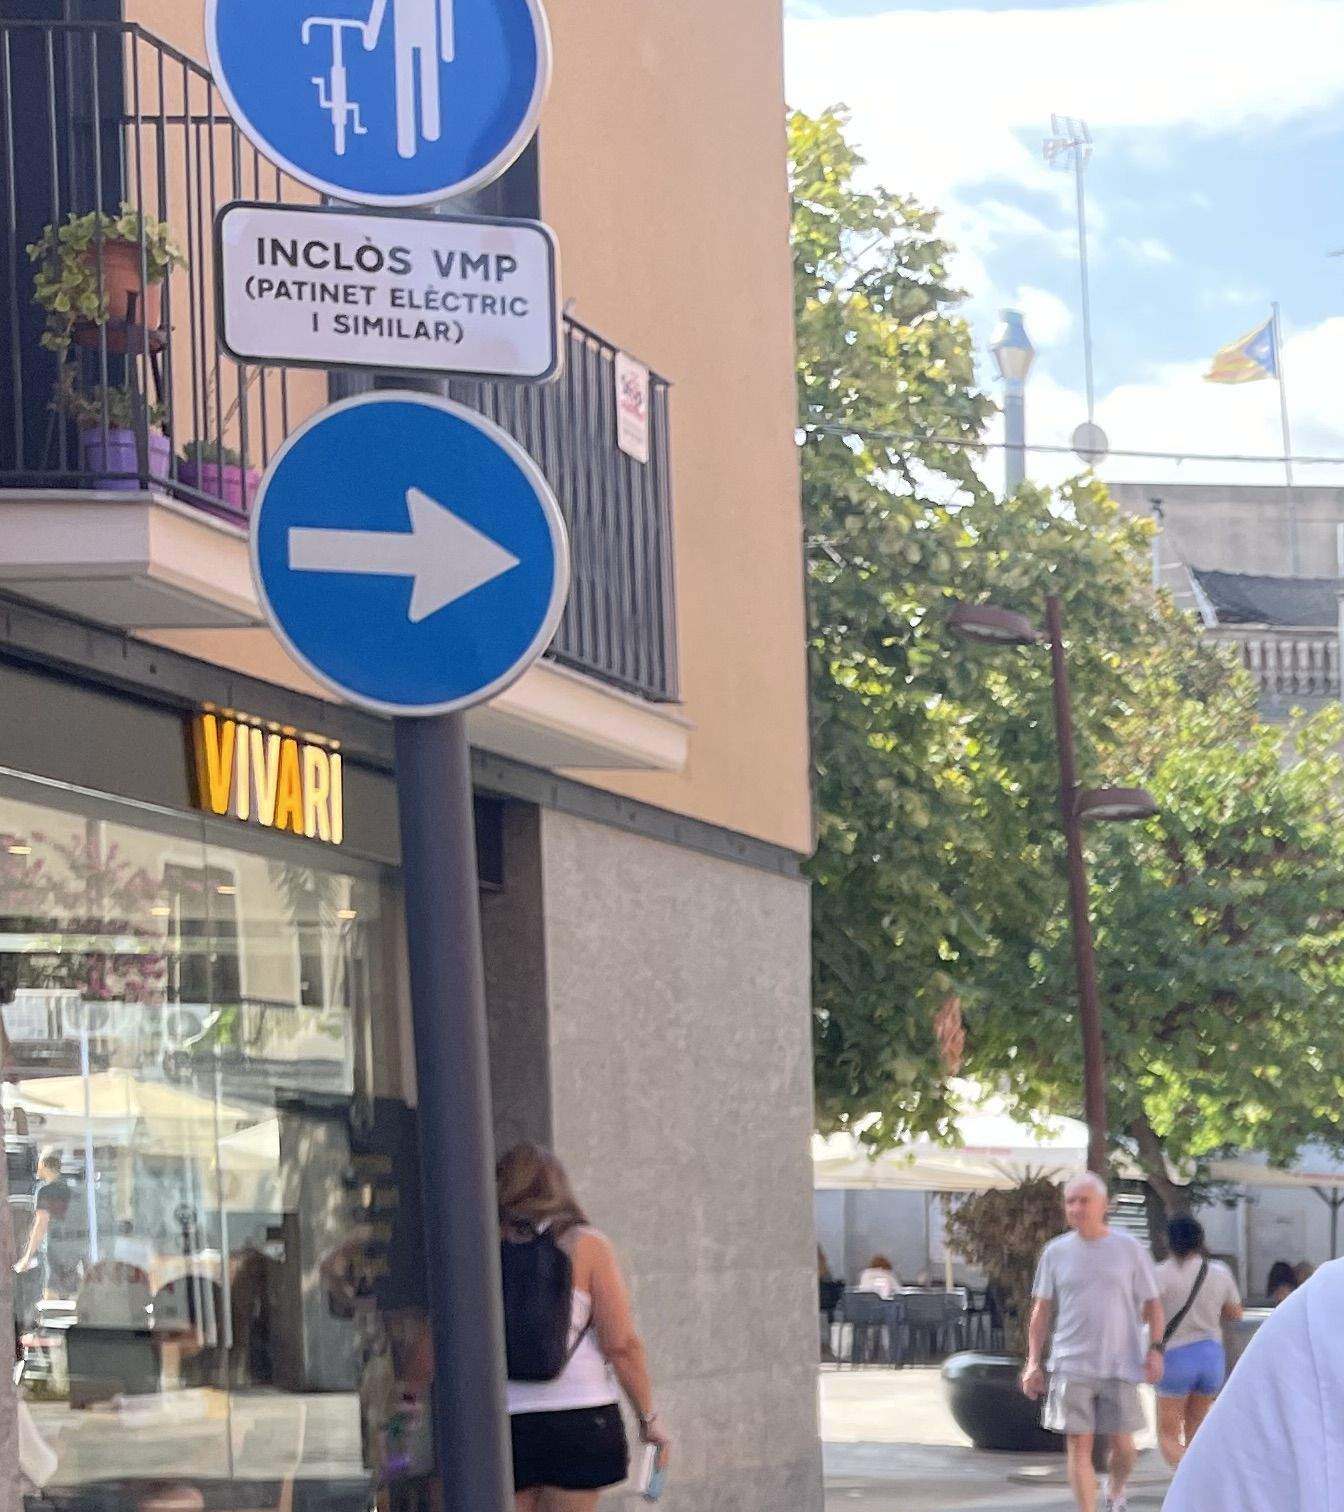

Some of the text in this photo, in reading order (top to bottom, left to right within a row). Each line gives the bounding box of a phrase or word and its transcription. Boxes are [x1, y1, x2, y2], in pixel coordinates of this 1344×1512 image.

[256, 234, 518, 283] INCLÒS VMP
[244, 275, 530, 318] (PATINET ELÈCTRIC
[312, 312, 465, 345] I SIMILAR)
[203, 713, 344, 845] VIVARI
